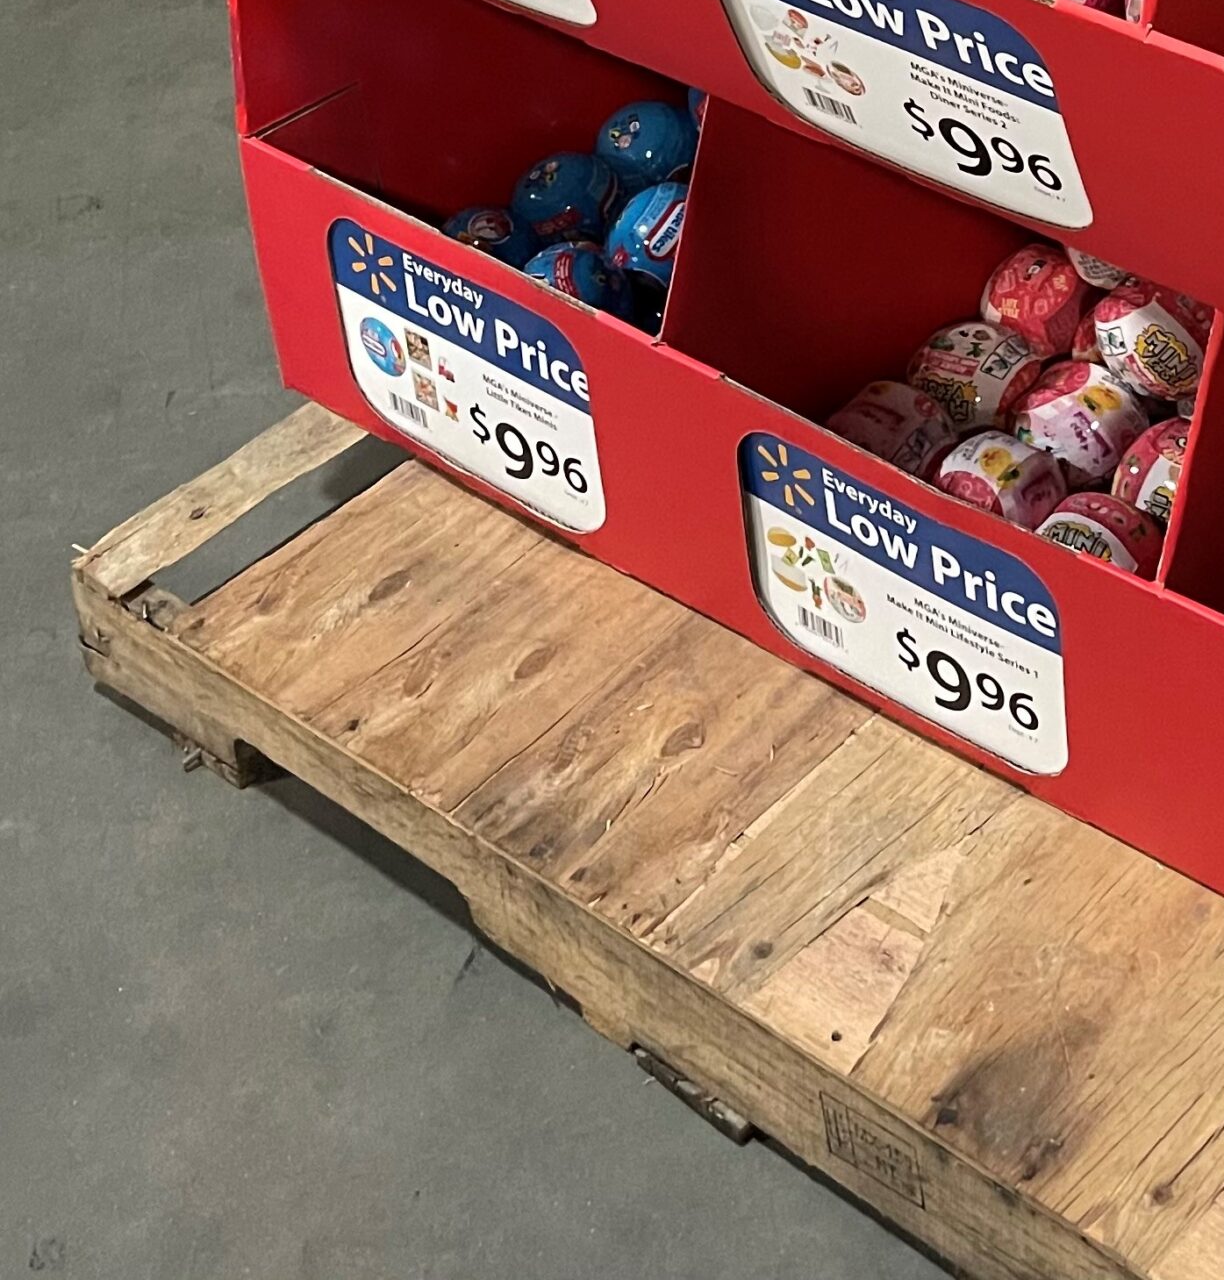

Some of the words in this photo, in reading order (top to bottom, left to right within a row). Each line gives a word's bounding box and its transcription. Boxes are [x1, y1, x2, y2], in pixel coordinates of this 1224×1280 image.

[916, 9, 1055, 98] Price
[402, 253, 484, 309] Everyday
[404, 273, 485, 344] Low
[495, 319, 590, 402] Price
[822, 467, 917, 534] Everyday
[824, 488, 919, 569] Low
[932, 546, 1057, 638] Price
